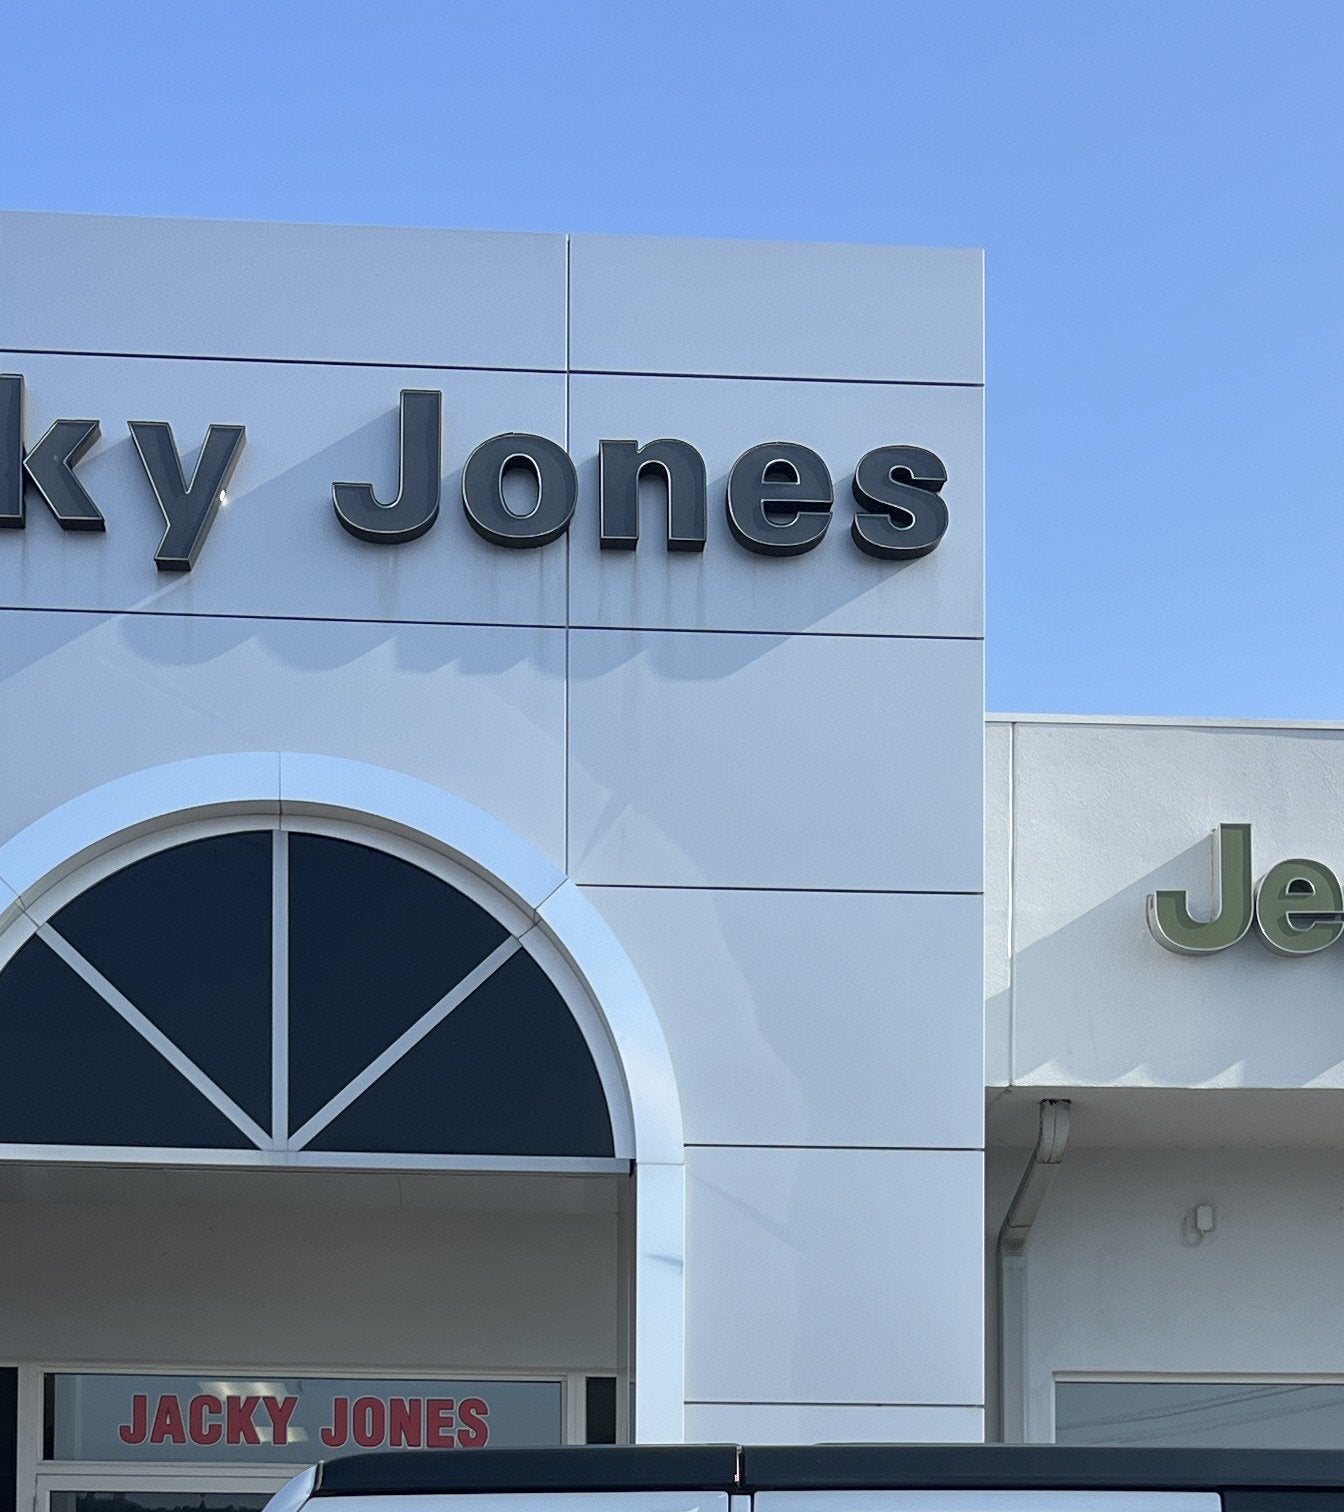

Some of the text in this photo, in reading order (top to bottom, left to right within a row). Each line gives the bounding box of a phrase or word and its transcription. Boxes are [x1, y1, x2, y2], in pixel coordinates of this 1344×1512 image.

[332, 389, 949, 560] Jones
[119, 1393, 489, 1449] JACKY JONES
